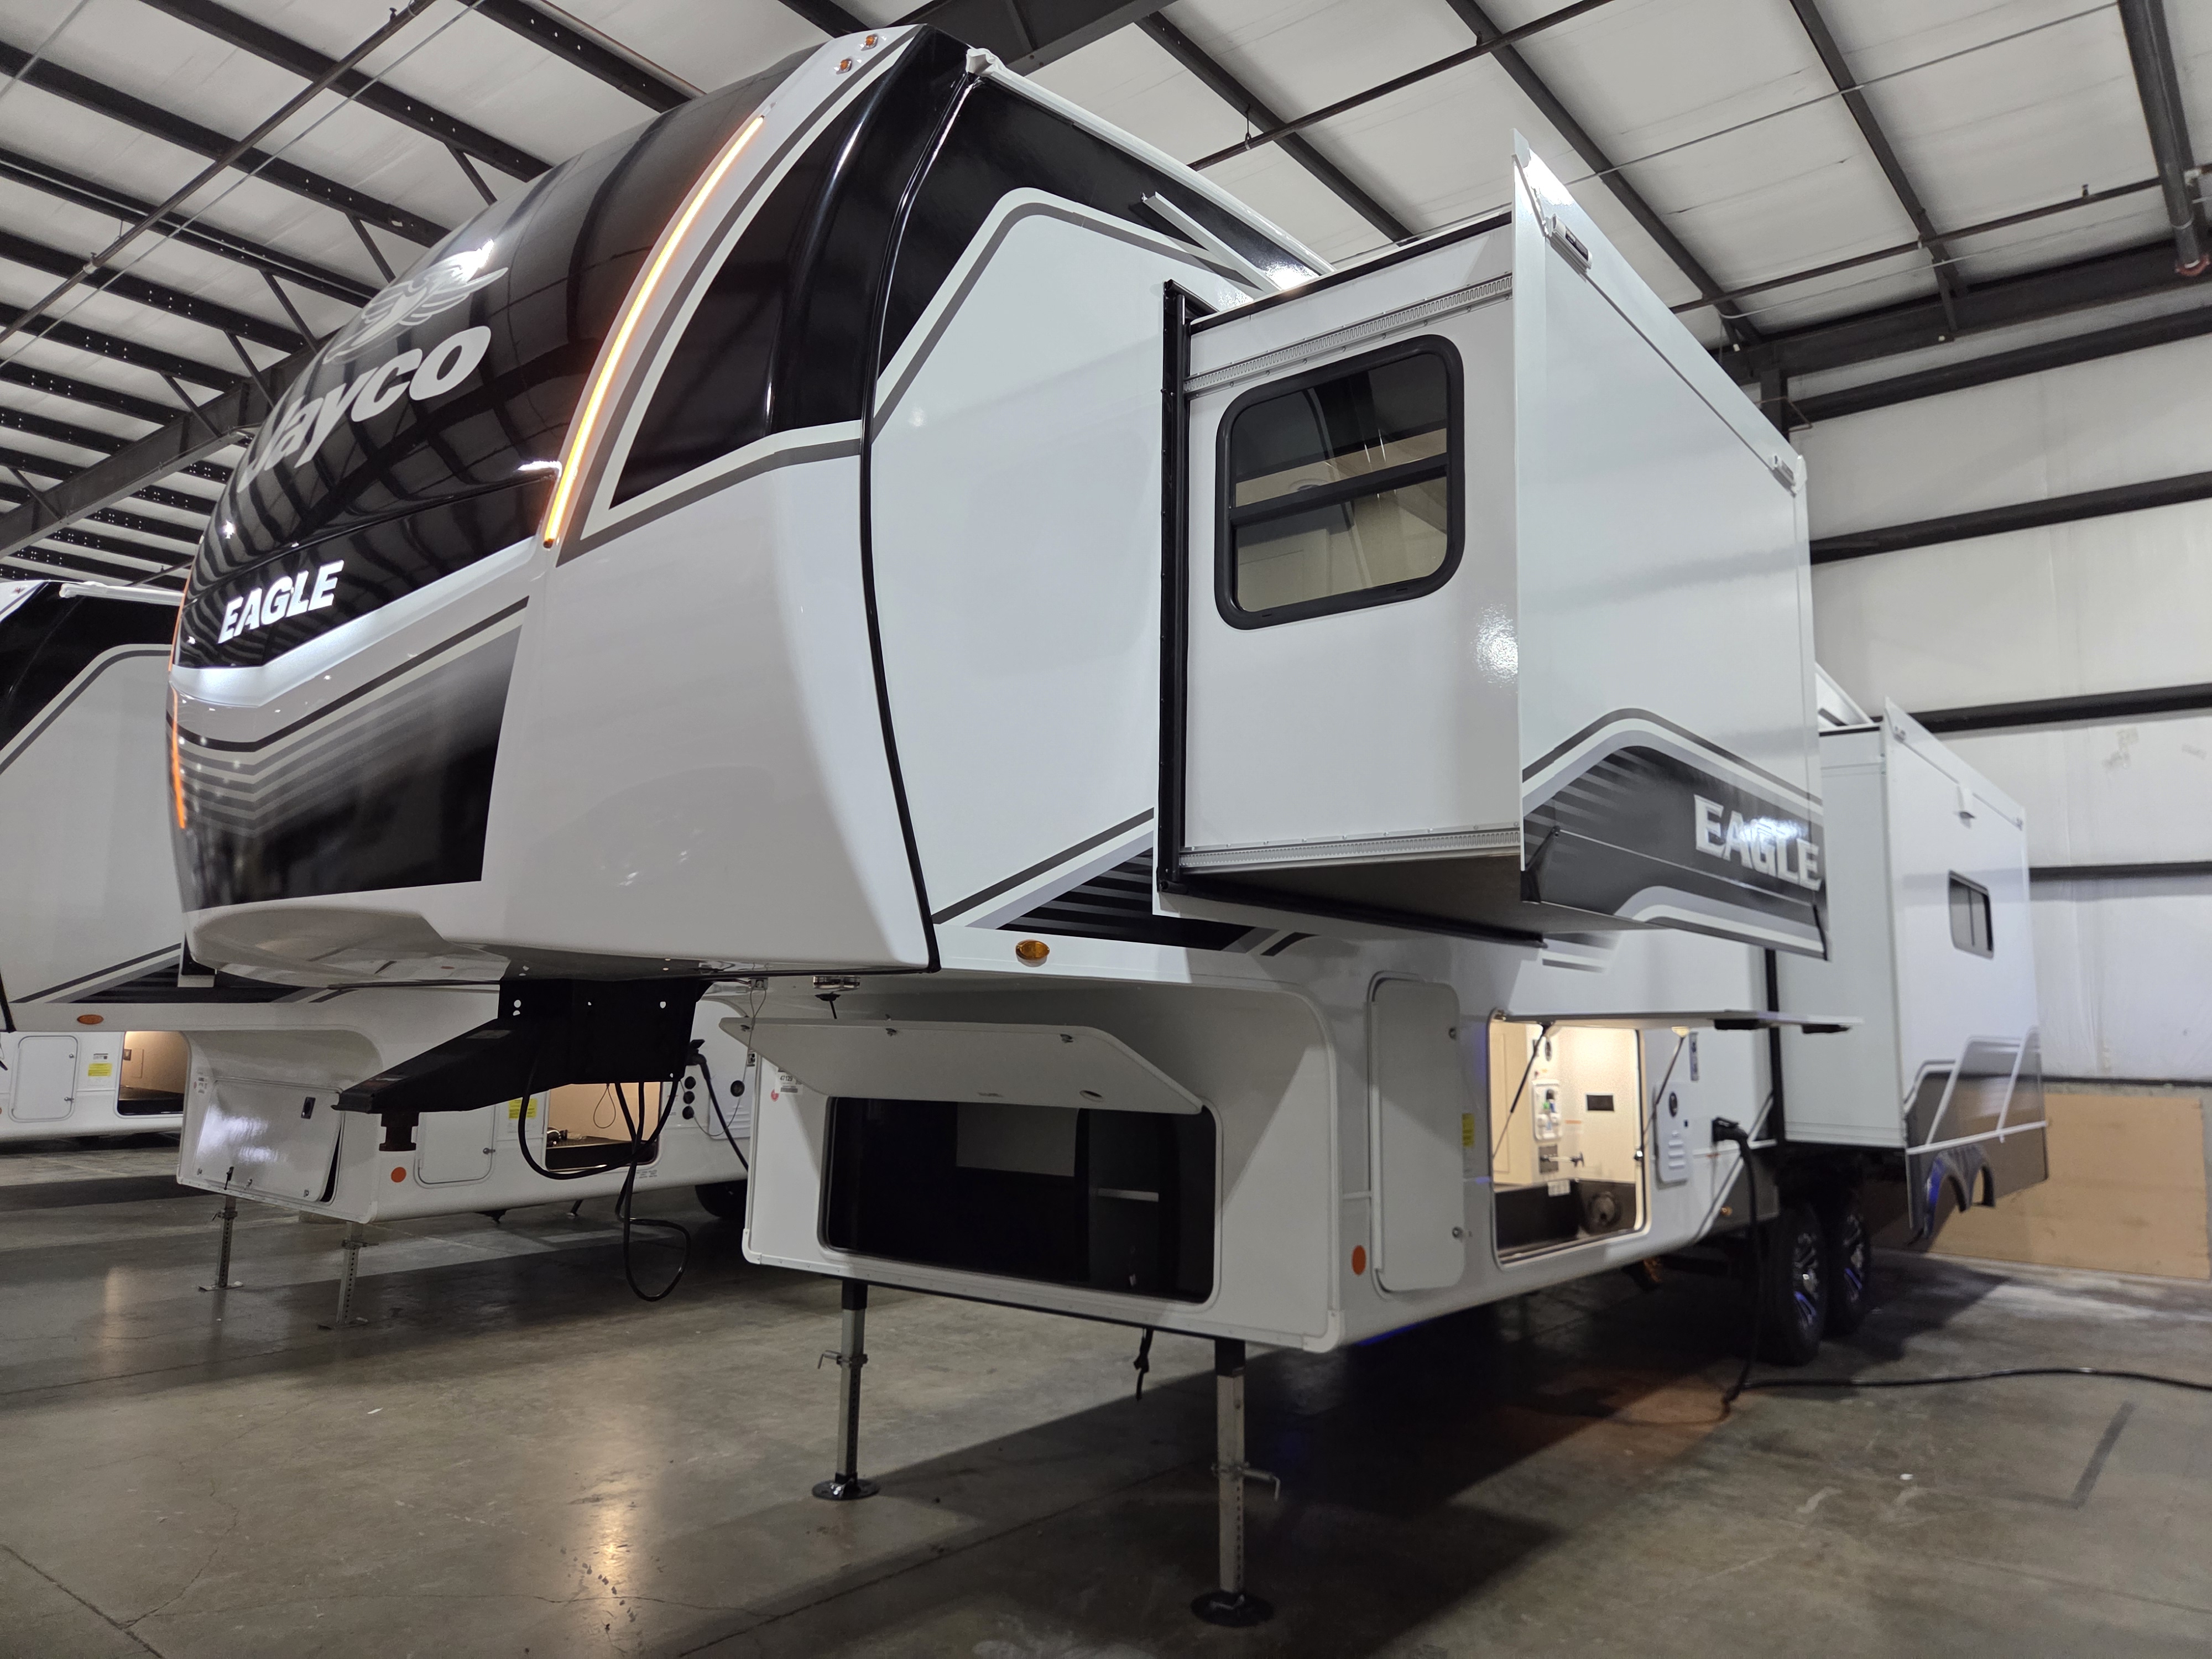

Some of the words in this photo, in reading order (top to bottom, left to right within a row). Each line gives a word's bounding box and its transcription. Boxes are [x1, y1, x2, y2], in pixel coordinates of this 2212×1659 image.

[237, 325, 491, 493] Jayco
[218, 560, 345, 644] EAGLE
[1694, 794, 1822, 891] EAGLE
